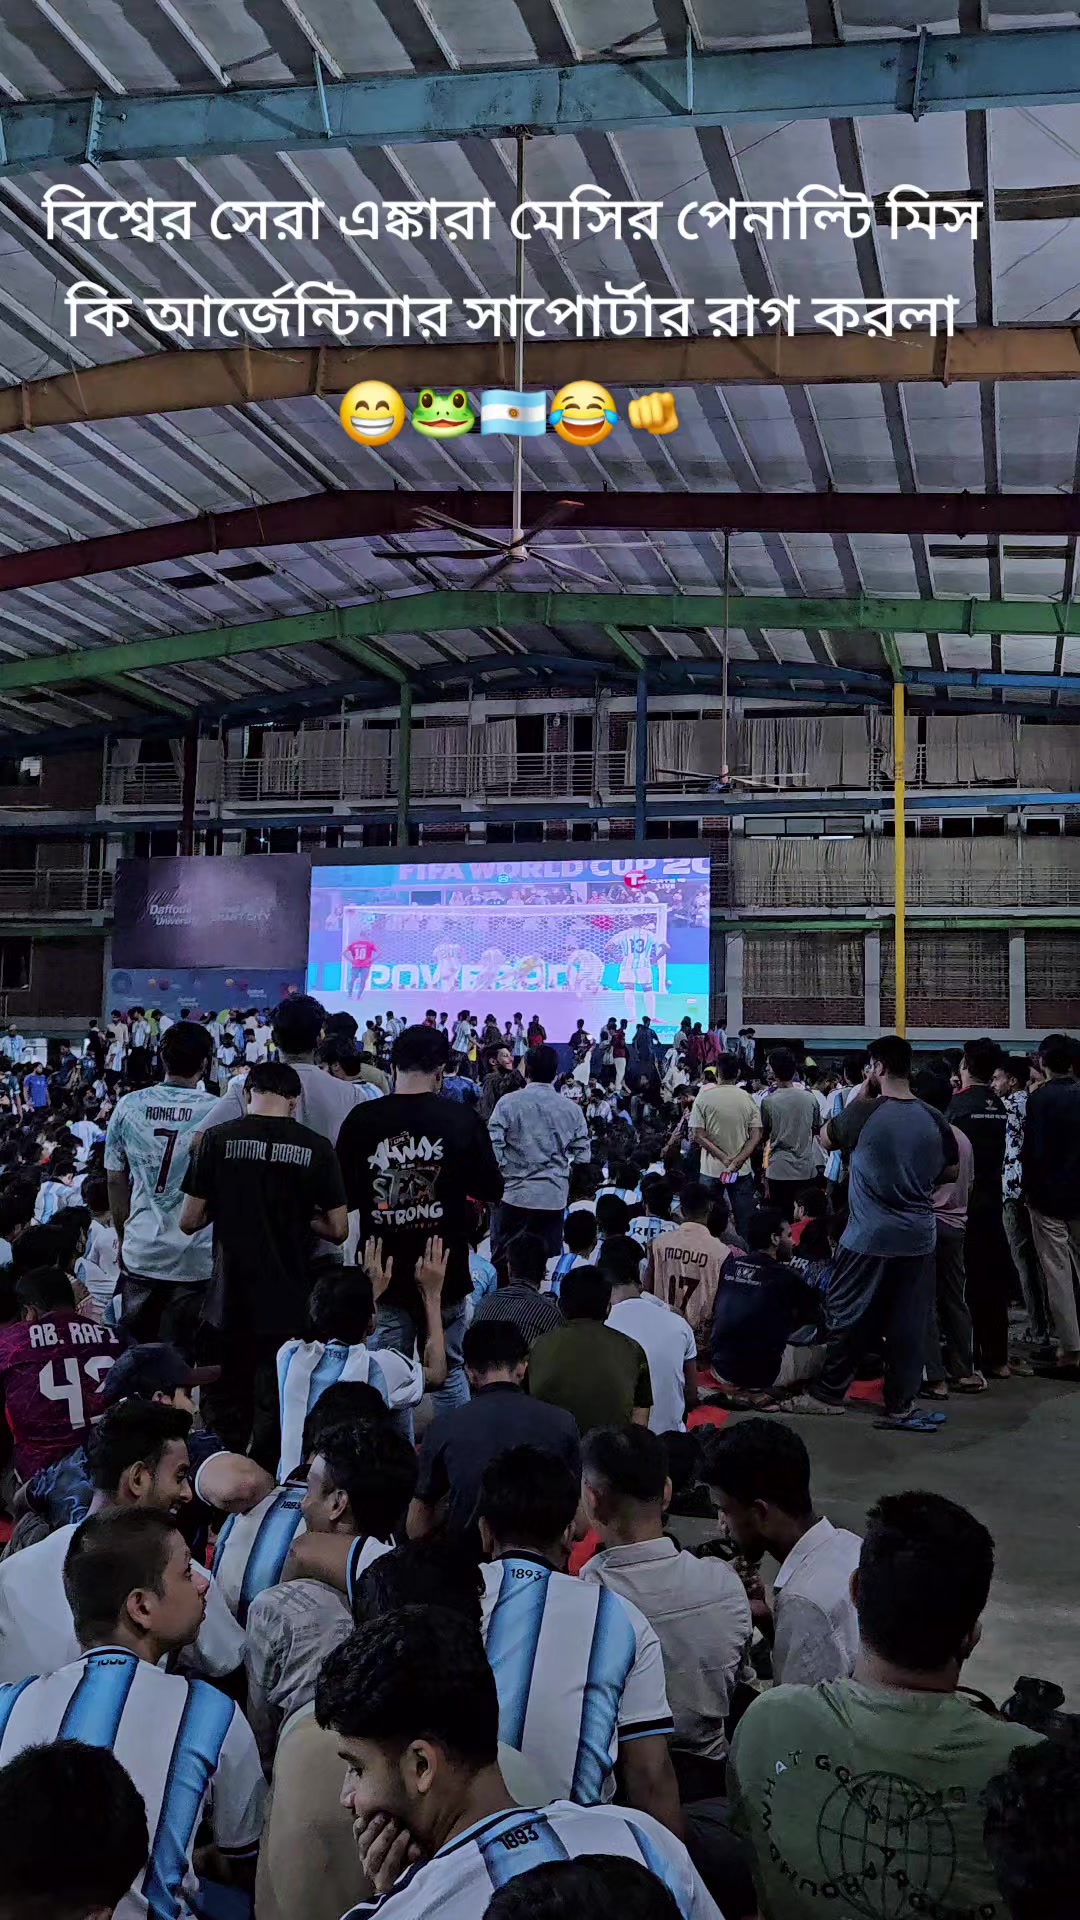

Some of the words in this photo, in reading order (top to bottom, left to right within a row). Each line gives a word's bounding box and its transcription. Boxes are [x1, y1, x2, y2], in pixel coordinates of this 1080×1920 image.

[399, 863, 465, 881] FIFA
[468, 860, 584, 880] WORLD
[590, 858, 656, 877] CUP
[629, 938, 645, 954] 13
[145, 1106, 193, 1122] RONALDO
[153, 1128, 179, 1194] 7
[371, 1201, 444, 1225] STRONG
[29, 1322, 65, 1349] AB.
[510, 1568, 543, 1582] 1893
[497, 1823, 539, 1850] 1893
